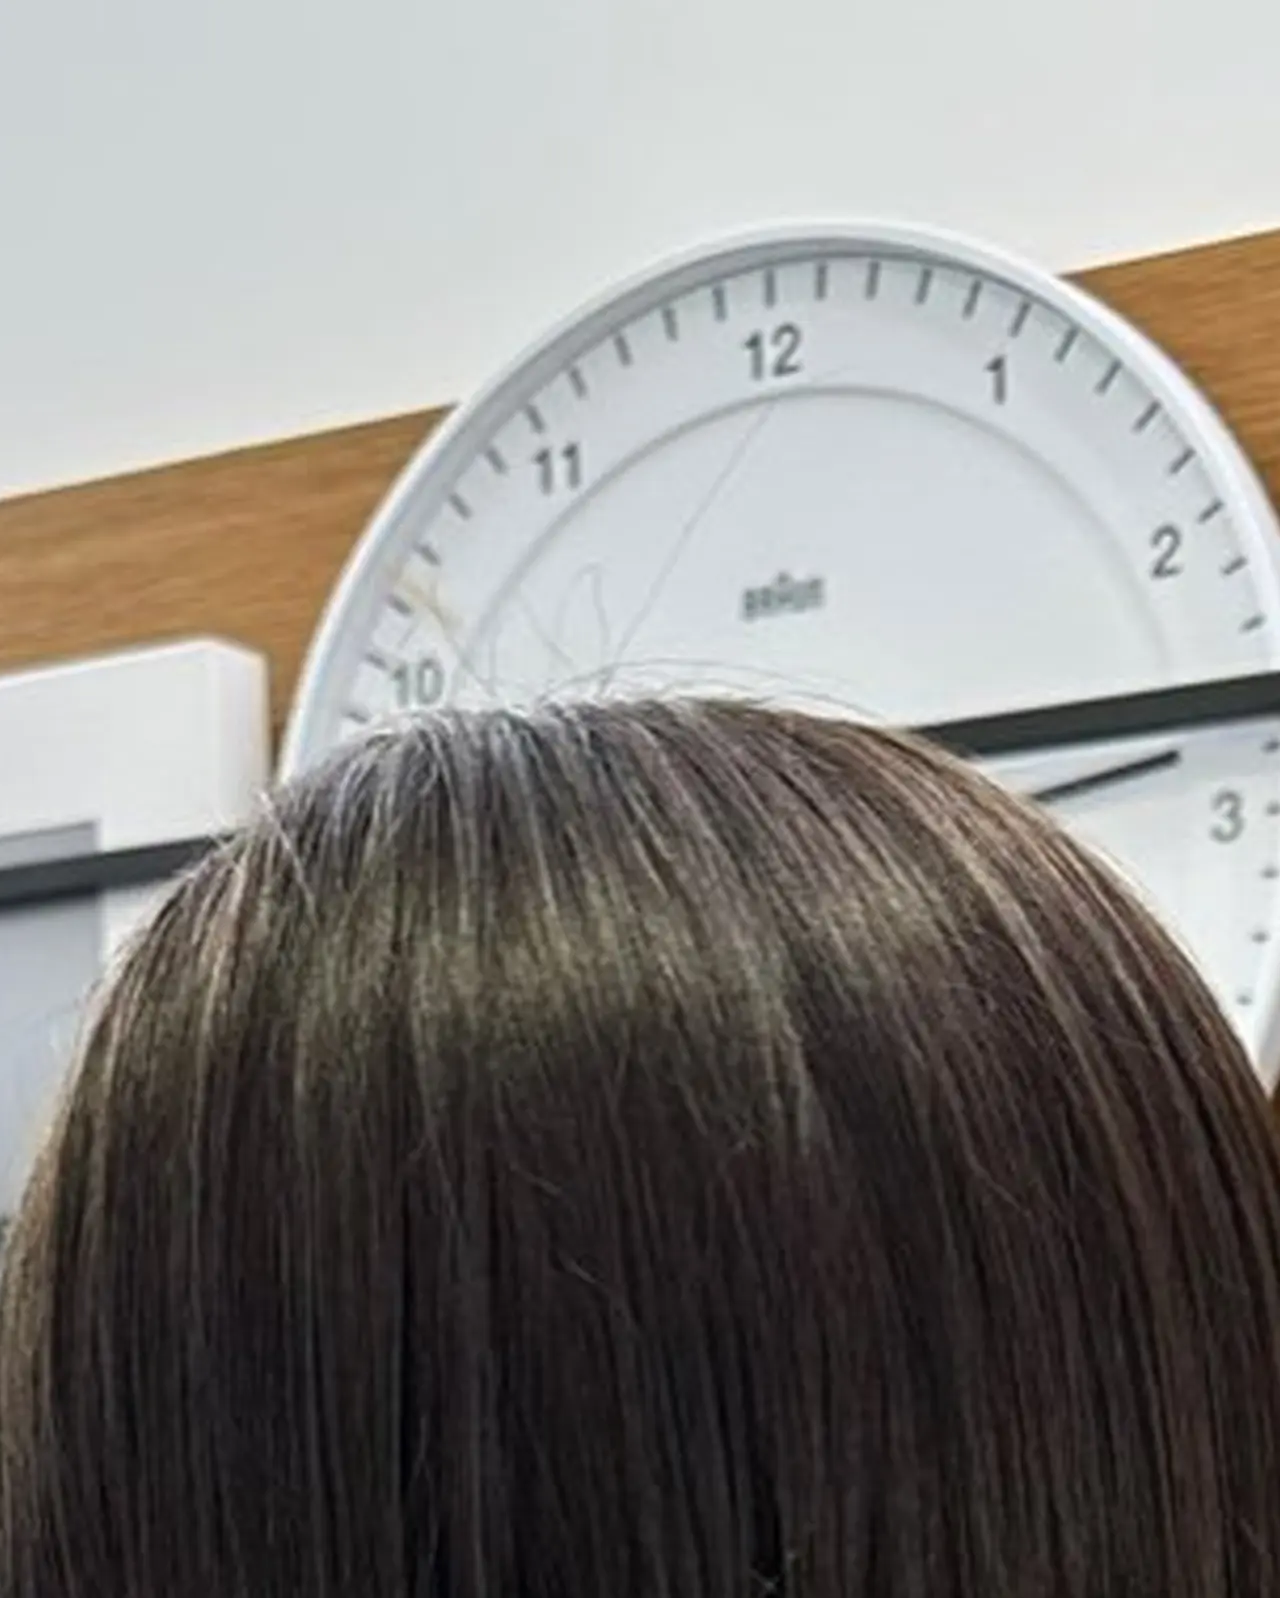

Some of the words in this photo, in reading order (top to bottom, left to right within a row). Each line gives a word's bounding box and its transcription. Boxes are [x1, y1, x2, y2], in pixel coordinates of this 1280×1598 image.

[742, 323, 803, 381] 12
[984, 356, 1007, 405] 1
[532, 442, 583, 496] 11
[1150, 524, 1183, 580] 2
[391, 656, 444, 708] 10
[1210, 789, 1245, 845] 3
